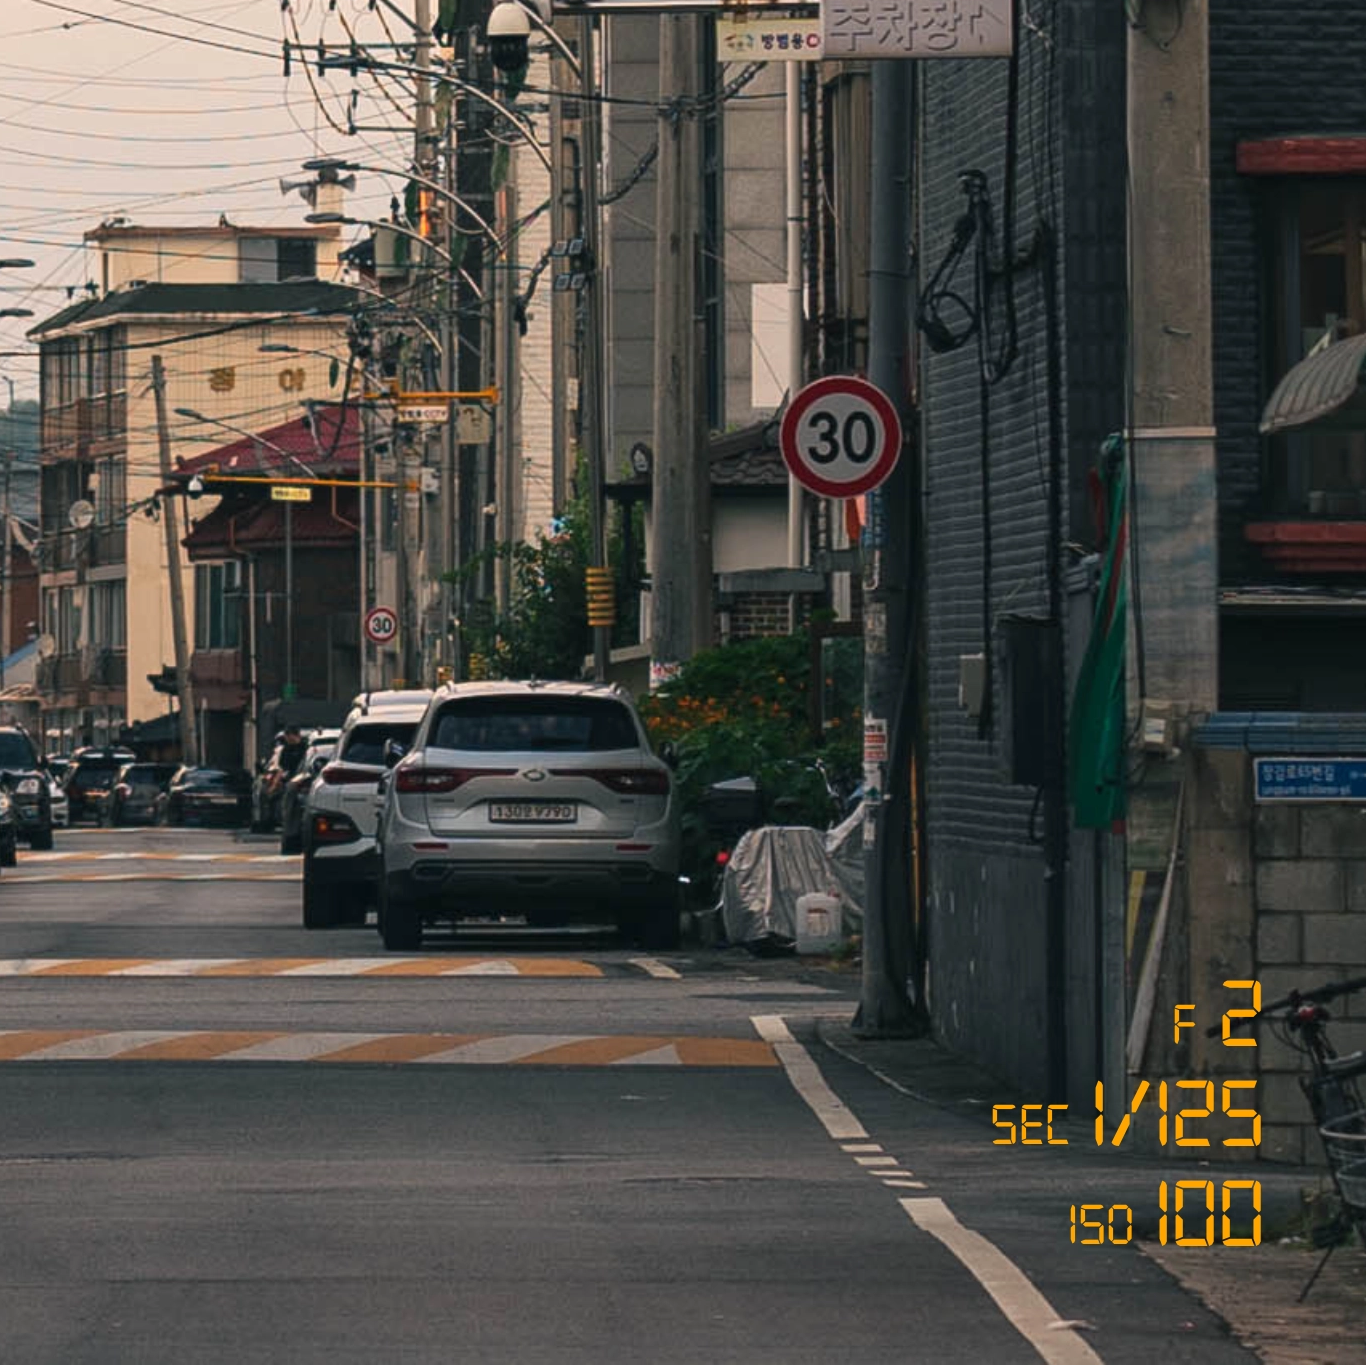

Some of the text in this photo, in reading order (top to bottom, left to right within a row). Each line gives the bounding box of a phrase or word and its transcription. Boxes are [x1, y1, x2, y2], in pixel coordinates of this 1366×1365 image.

[831, 0, 963, 51] 주차장
[807, 410, 876, 464] 30
[372, 616, 393, 634] 30
